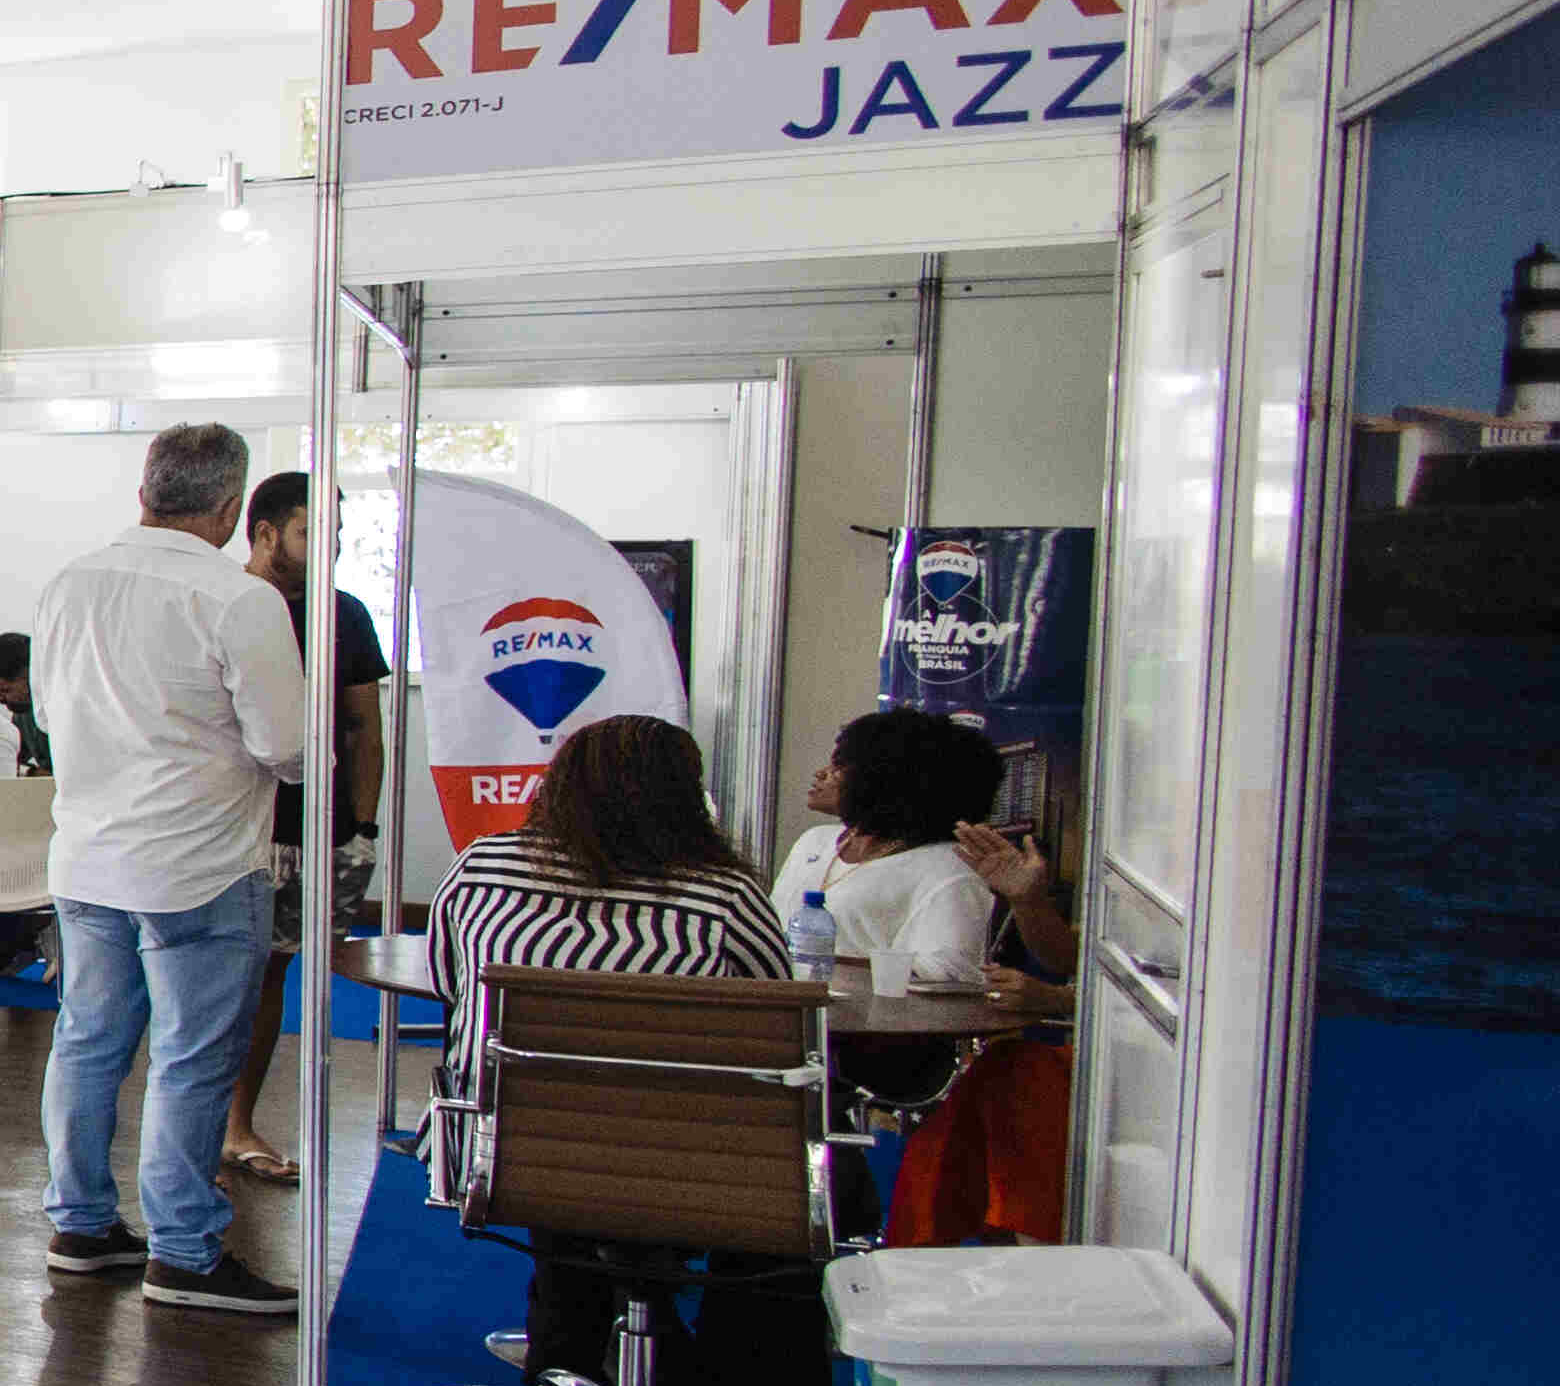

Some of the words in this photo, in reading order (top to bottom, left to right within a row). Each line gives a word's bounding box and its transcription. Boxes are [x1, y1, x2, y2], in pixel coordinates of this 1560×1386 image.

[782, 42, 1127, 140] JAZZ
[344, 104, 414, 125] CRECI
[420, 96, 504, 118] 2.071-J
[895, 613, 1020, 645] melhor
[492, 631, 594, 658] RE/MAX
[918, 659, 967, 670] BRASIL
[471, 774, 545, 805] RE/
